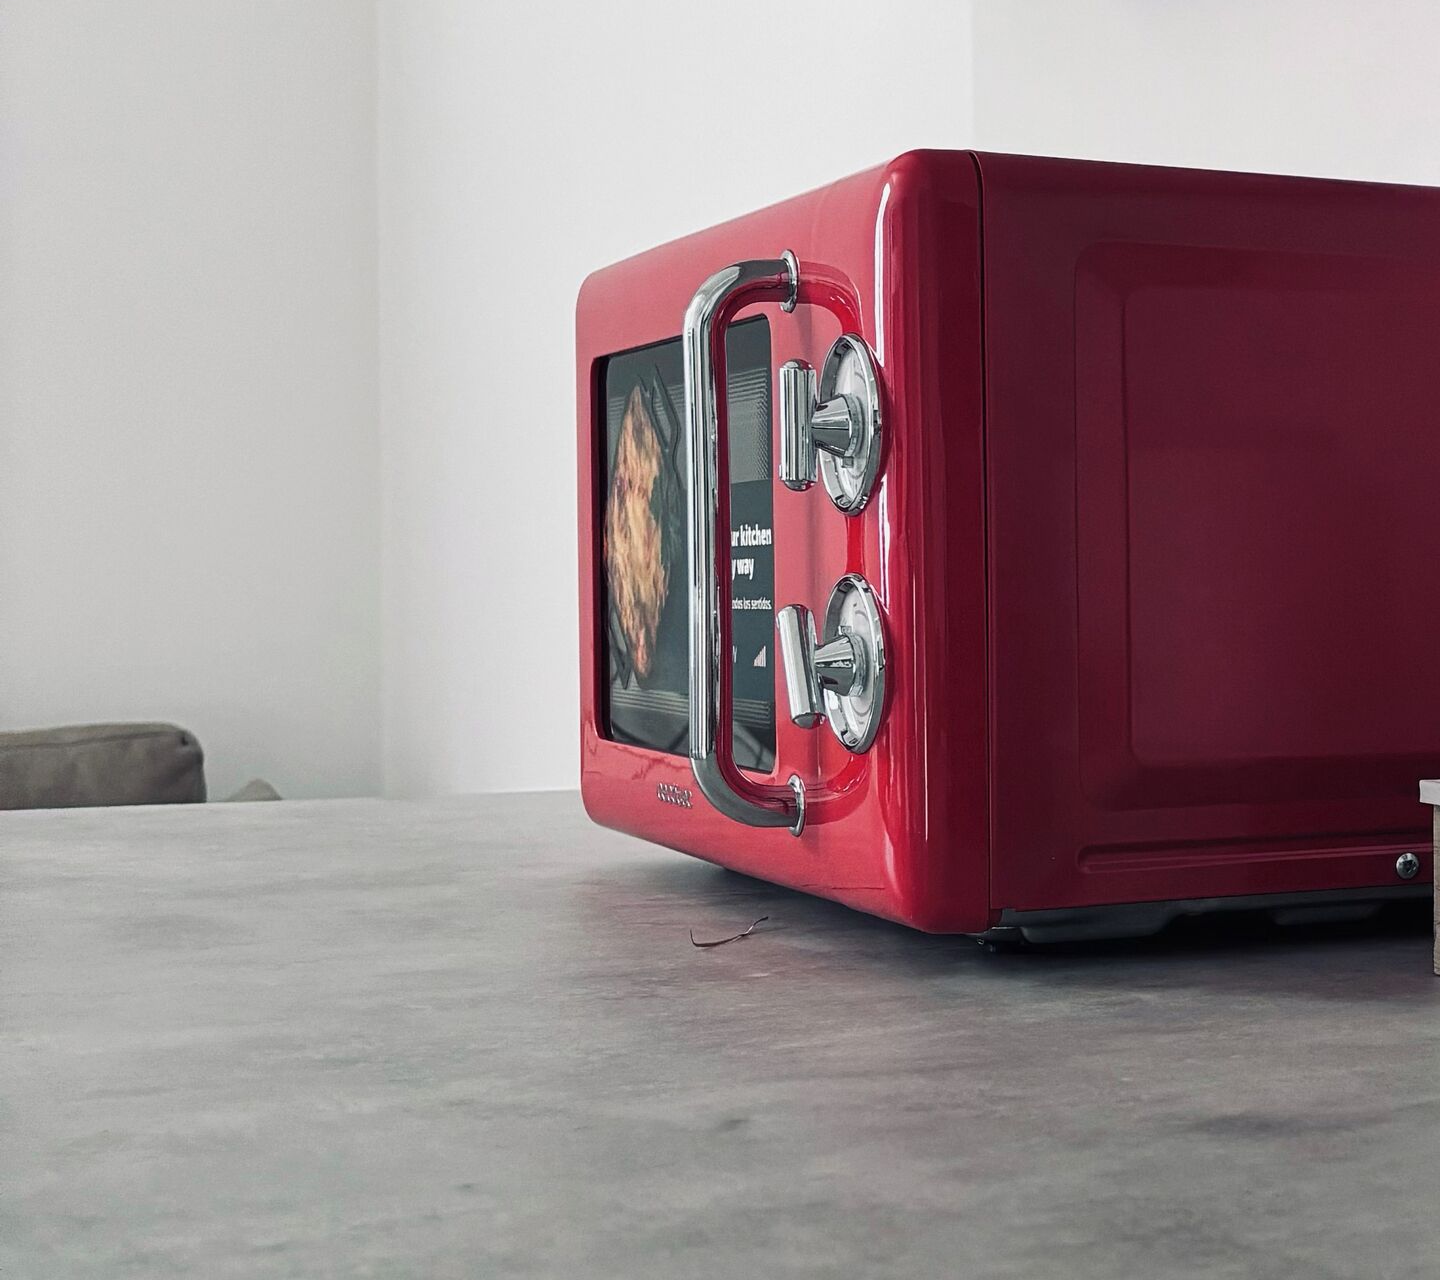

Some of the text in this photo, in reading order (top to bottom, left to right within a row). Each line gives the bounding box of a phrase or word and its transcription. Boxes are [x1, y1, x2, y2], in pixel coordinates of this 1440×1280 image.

[731, 523, 772, 547] ur kitchen
[737, 558, 754, 581] way
